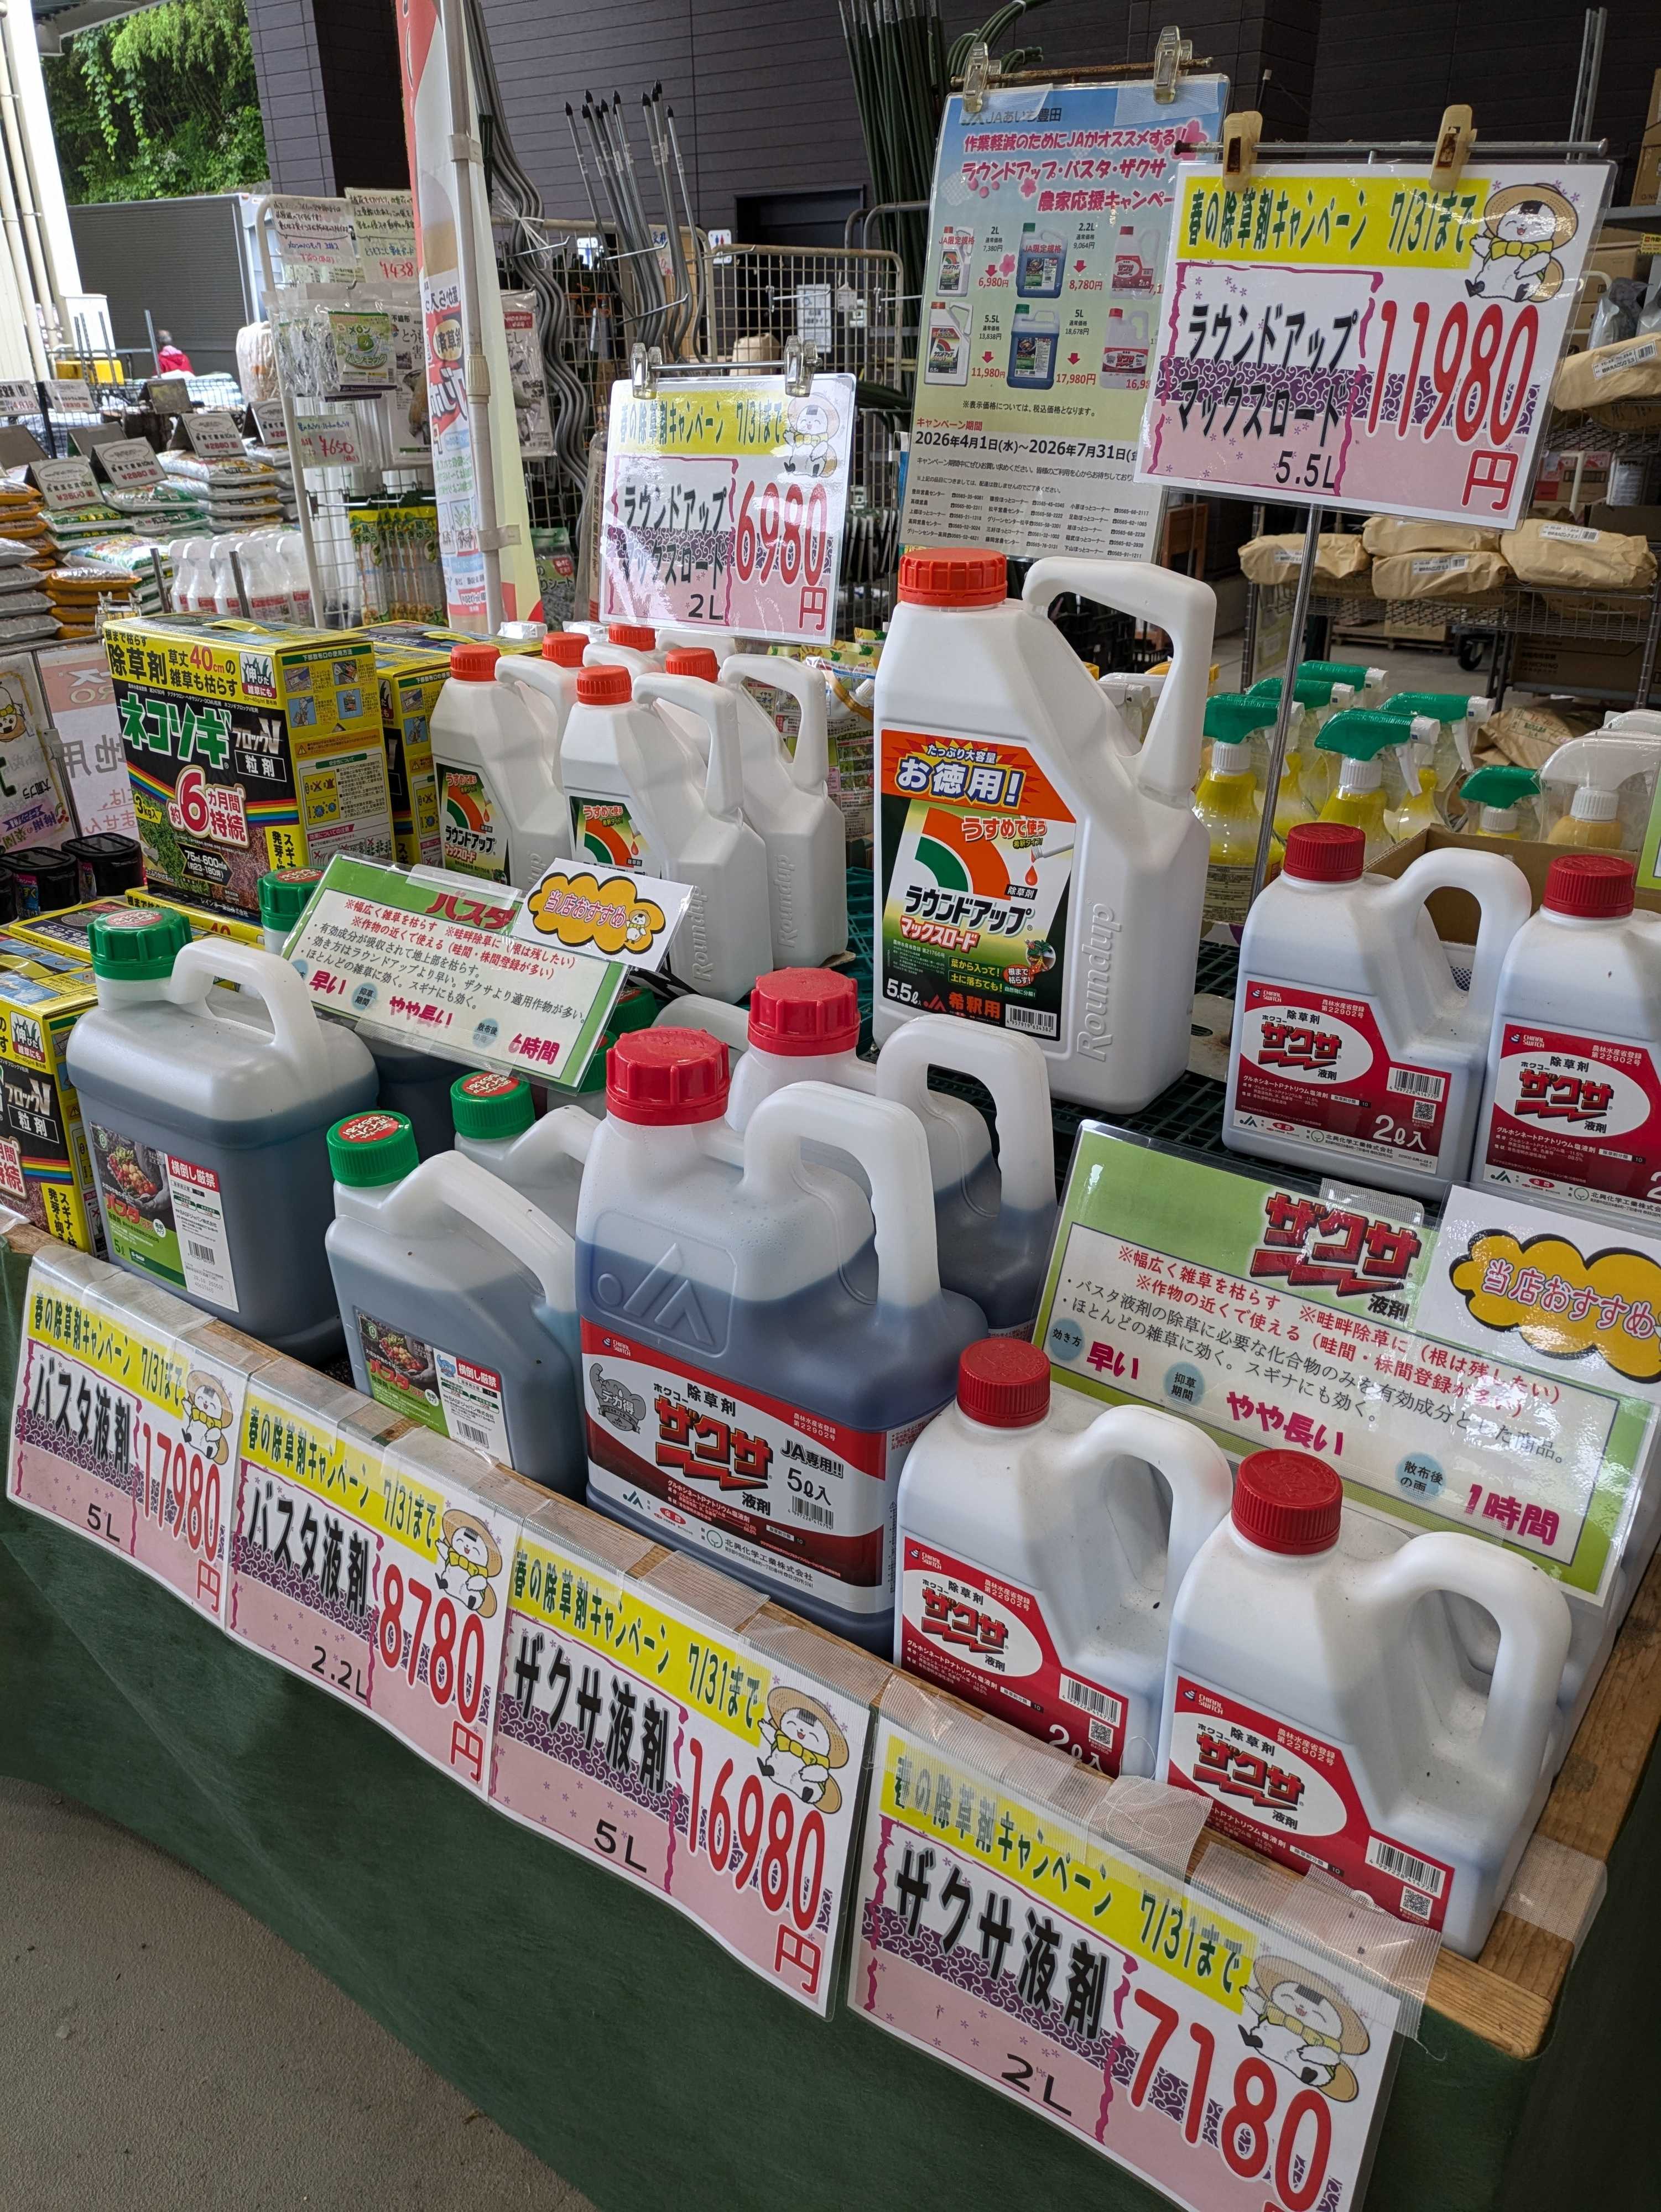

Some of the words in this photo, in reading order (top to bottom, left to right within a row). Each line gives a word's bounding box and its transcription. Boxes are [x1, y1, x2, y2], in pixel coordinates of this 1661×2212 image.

[986, 107, 1062, 124] JAあいち豊田
[961, 159, 1167, 182] ラウンドアップ・バスタ・ザクサ
[1079, 223, 1095, 231] 2.2L
[1188, 188, 1367, 250] 春の除草剤キャンペーン
[939, 236, 975, 245] JA限定規格
[1023, 243, 1062, 254] JA限定規格
[978, 277, 1009, 289] 6,980円
[1069, 279, 1103, 291] 8,780円
[391, 314, 410, 323] 不織布
[985, 314, 999, 324] 5.5L
[1188, 303, 1358, 374] ラウンドアップ
[971, 367, 1006, 380] 11,980円
[1056, 373, 1096, 385] 17,980円
[1367, 299, 1539, 445] 11980
[962, 400, 1096, 416] ※表示価格については、税込価格となります。
[1178, 379, 1346, 447] マックスロード
[917, 417, 982, 431] キャンペーン期間
[1275, 450, 1335, 490] 5.5L
[1461, 450, 1519, 510] 円
[624, 483, 727, 535] ラウンドアップ
[735, 480, 827, 586] 6980
[688, 593, 723, 620] 2L
[799, 586, 827, 631] 円
[105, 630, 148, 646] 根まで枯らす
[108, 643, 167, 685] 除草剤
[244, 663, 271, 686] 伸びた
[169, 668, 238, 697] 雑草も枯らす
[247, 685, 273, 697] 雑草にも
[120, 691, 232, 770] ネコソギ
[246, 755, 275, 777] 粒剤
[926, 743, 997, 765] たっぷり大容量
[445, 773, 477, 787] うすめて使う
[134, 795, 158, 820] 3kg入
[583, 805, 624, 820] うすめて使う
[210, 809, 246, 842] 持続
[445, 826, 497, 854] ラウンドアップ
[961, 816, 1048, 842] うすめて使う
[445, 843, 477, 864] マックスロード
[1007, 886, 1035, 899] 除草剤
[425, 891, 518, 930] バスタ
[544, 889, 627, 930] 当店おすすめ
[904, 885, 1034, 936] ラウンドアップ
[688, 886, 713, 982] Roundup
[899, 916, 980, 952] マックスロード
[308, 968, 347, 995] 早い
[1076, 902, 1122, 1061] Roundup
[389, 995, 454, 1029] やや長い
[948, 992, 1001, 1019] 希釈用
[1262, 1014, 1287, 1023] ホクコー
[1287, 1009, 1320, 1025] 除草剤
[16, 1026, 39, 1048] 伸びた
[18, 1043, 42, 1061] 雑草にも
[508, 1032, 560, 1065] 6時間
[1261, 1021, 1342, 1060] ザクサ
[1318, 1068, 1337, 1081] 液剤
[1521, 1061, 1550, 1071] ホクコー
[1550, 1056, 1590, 1073] 除草剤
[1243, 1074, 1329, 1099] グルホシネートPナトリウム塩液剤
[1519, 1068, 1615, 1111] ザクサ
[17, 1110, 48, 1138] 粒剤
[1584, 1120, 1607, 1134] 液剤
[1325, 1134, 1394, 1154] 北興化学工業株式会社
[1497, 1126, 1596, 1154] グルホシネートPナトリウム塩液剤
[170, 1159, 216, 1188] 横倒し厳禁
[1264, 1190, 1422, 1282] ザクサ
[1119, 1244, 1281, 1312] ※幅広く雑草を枯らす
[1368, 1292, 1408, 1323] 液剤
[1481, 1256, 1661, 1344] 当店おすすめ
[33, 1291, 131, 1376] 春の除草剤キャンペーン
[141, 1344, 184, 1408] 7/31まで
[1052, 1326, 1082, 1349] 効き方
[458, 1363, 497, 1388] 横倒し厳禁
[1085, 1340, 1139, 1381] 早い
[602, 1390, 635, 1415] デカ得
[653, 1383, 689, 1404] ホクコー
[687, 1383, 736, 1417] 除草剤
[32, 1357, 132, 1476] バスタ液剤
[1226, 1391, 1345, 1457] やや長い
[654, 1396, 774, 1481] ザクサ
[142, 1422, 221, 1563] 17980
[248, 1405, 370, 1510] 春の除草剤キャンペーン
[383, 1477, 437, 1550] 7/31まで
[742, 1490, 771, 1516] 液剤
[1466, 1483, 1561, 1547] 1時間
[87, 1503, 120, 1543] 5L
[248, 1480, 369, 1619] バスタ液剤
[724, 1539, 814, 1582] 北興化学工業株式会社
[197, 1559, 221, 1613] 円
[922, 1579, 949, 1595] ホクコー
[948, 1580, 984, 1606] 除草剤
[921, 1587, 1009, 1650] ザクサ
[379, 1562, 484, 1724] 8780
[512, 1549, 670, 1675] 春の除草剤キャンペーン
[688, 1641, 761, 1731] 7/31まで
[311, 1645, 368, 1701] 2.2L
[907, 1639, 998, 1691] グルホシネートPナトリウム塩液剤
[985, 1654, 1006, 1672] 液剤
[513, 1634, 671, 1795] ザクサ液剤
[1199, 1693, 1223, 1709] CHIRAL
[1199, 1699, 1223, 1715] SWITCH
[1197, 1723, 1231, 1743] ホクコー
[1230, 1726, 1275, 1756] 除草剤
[450, 1719, 484, 1782] 円
[1277, 1736, 1334, 1766] 第22902号
[1196, 1731, 1305, 1806] ザクサ
[688, 1736, 826, 1932] 16980
[1272, 1809, 1298, 1830] 液剤
[593, 1819, 648, 1874] 5L
[891, 1752, 1113, 1918] 春の除草剤キャンペーン
[893, 1844, 1111, 2041] ザクサ液剤
[774, 1924, 822, 1996] 円
[1001, 2053, 1073, 2118] 2L
[1128, 1986, 1333, 2209] 7180
